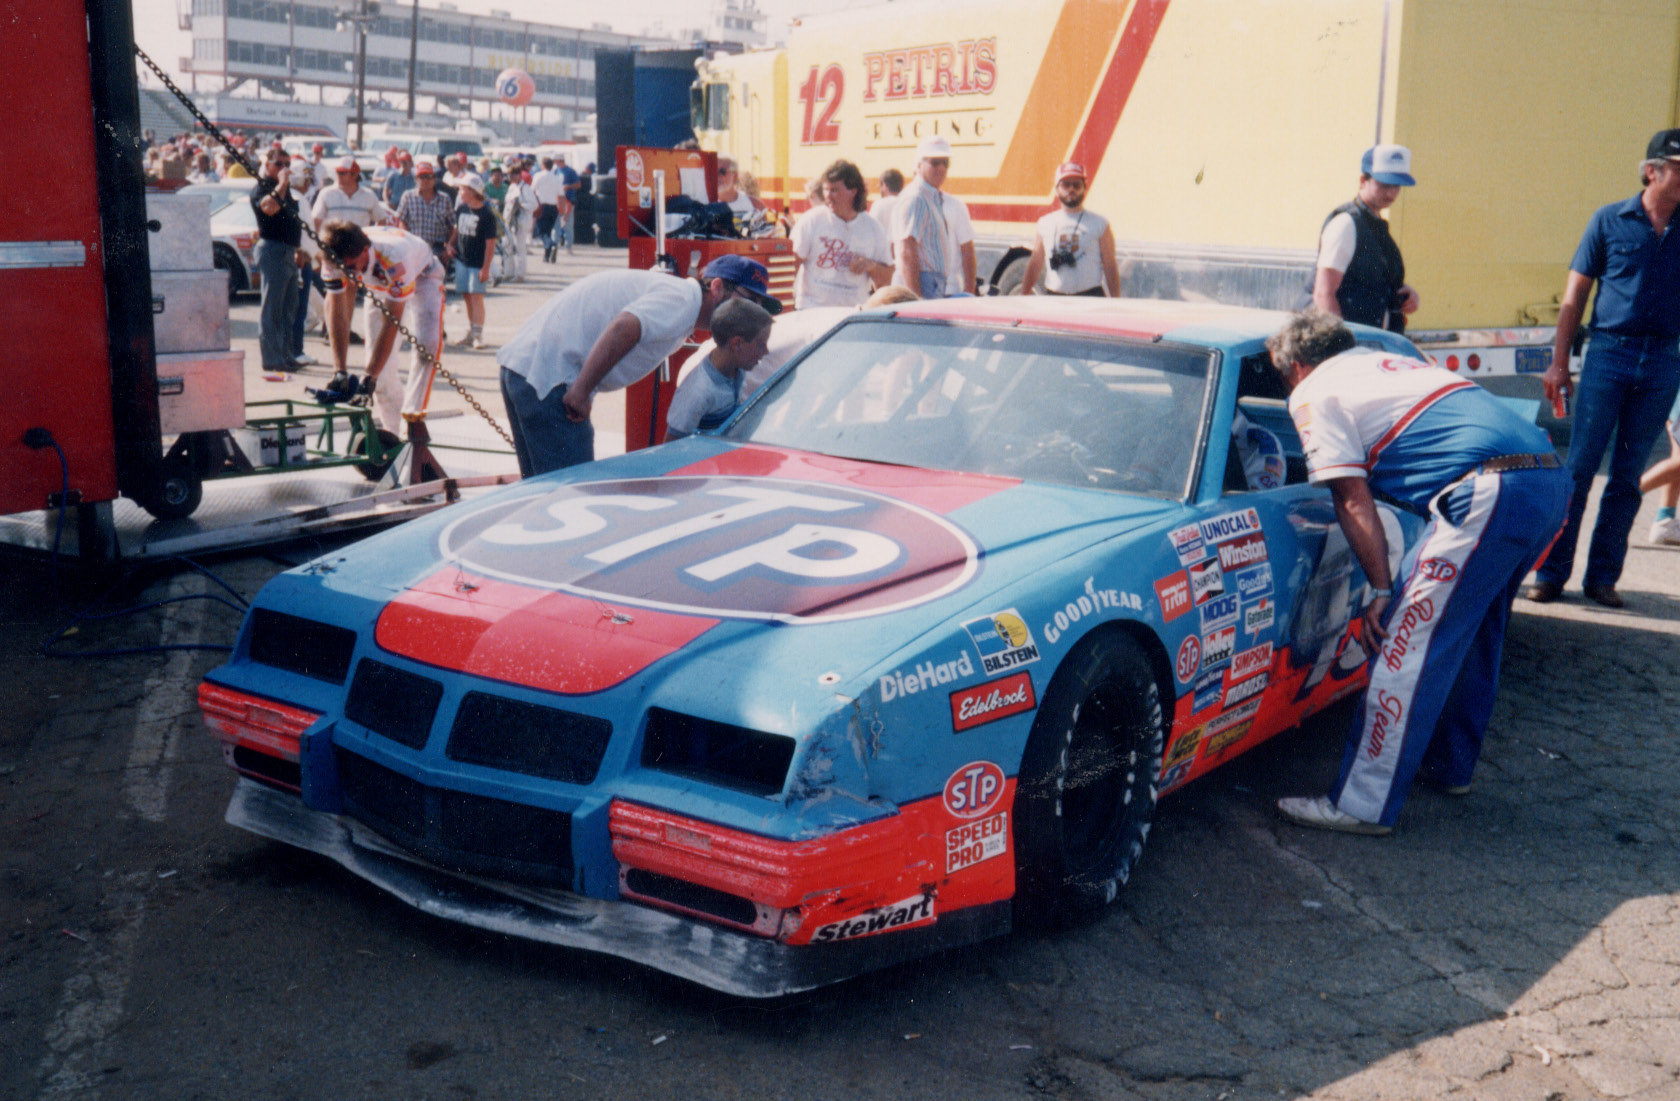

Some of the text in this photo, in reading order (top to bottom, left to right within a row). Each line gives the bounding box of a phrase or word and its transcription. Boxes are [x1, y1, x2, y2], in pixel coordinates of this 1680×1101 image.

[488, 55, 571, 77] RIVERSIDE
[863, 37, 997, 102] PETRIS
[799, 65, 843, 145] 12
[873, 117, 985, 139] RACING
[260, 435, 306, 449] Dieard
[480, 486, 901, 582] STP
[1203, 514, 1251, 540] UNOCAL
[1219, 540, 1267, 567] Winston
[1195, 571, 1219, 592] CHAMPION
[1422, 559, 1455, 579] STP
[1161, 581, 1188, 612] TRW
[1203, 596, 1237, 623] MOOG
[984, 645, 1038, 672] BILSTEIN
[1179, 640, 1198, 676] STP
[1234, 646, 1271, 674] SIMPSON
[880, 649, 974, 702] DieHard
[1368, 589, 1434, 760] Racing Team
[958, 683, 1027, 721] Edelbrock
[951, 766, 997, 810] STP
[948, 815, 1002, 850] SPEED
[949, 841, 983, 871] PRO
[815, 898, 932, 943] Stewart
